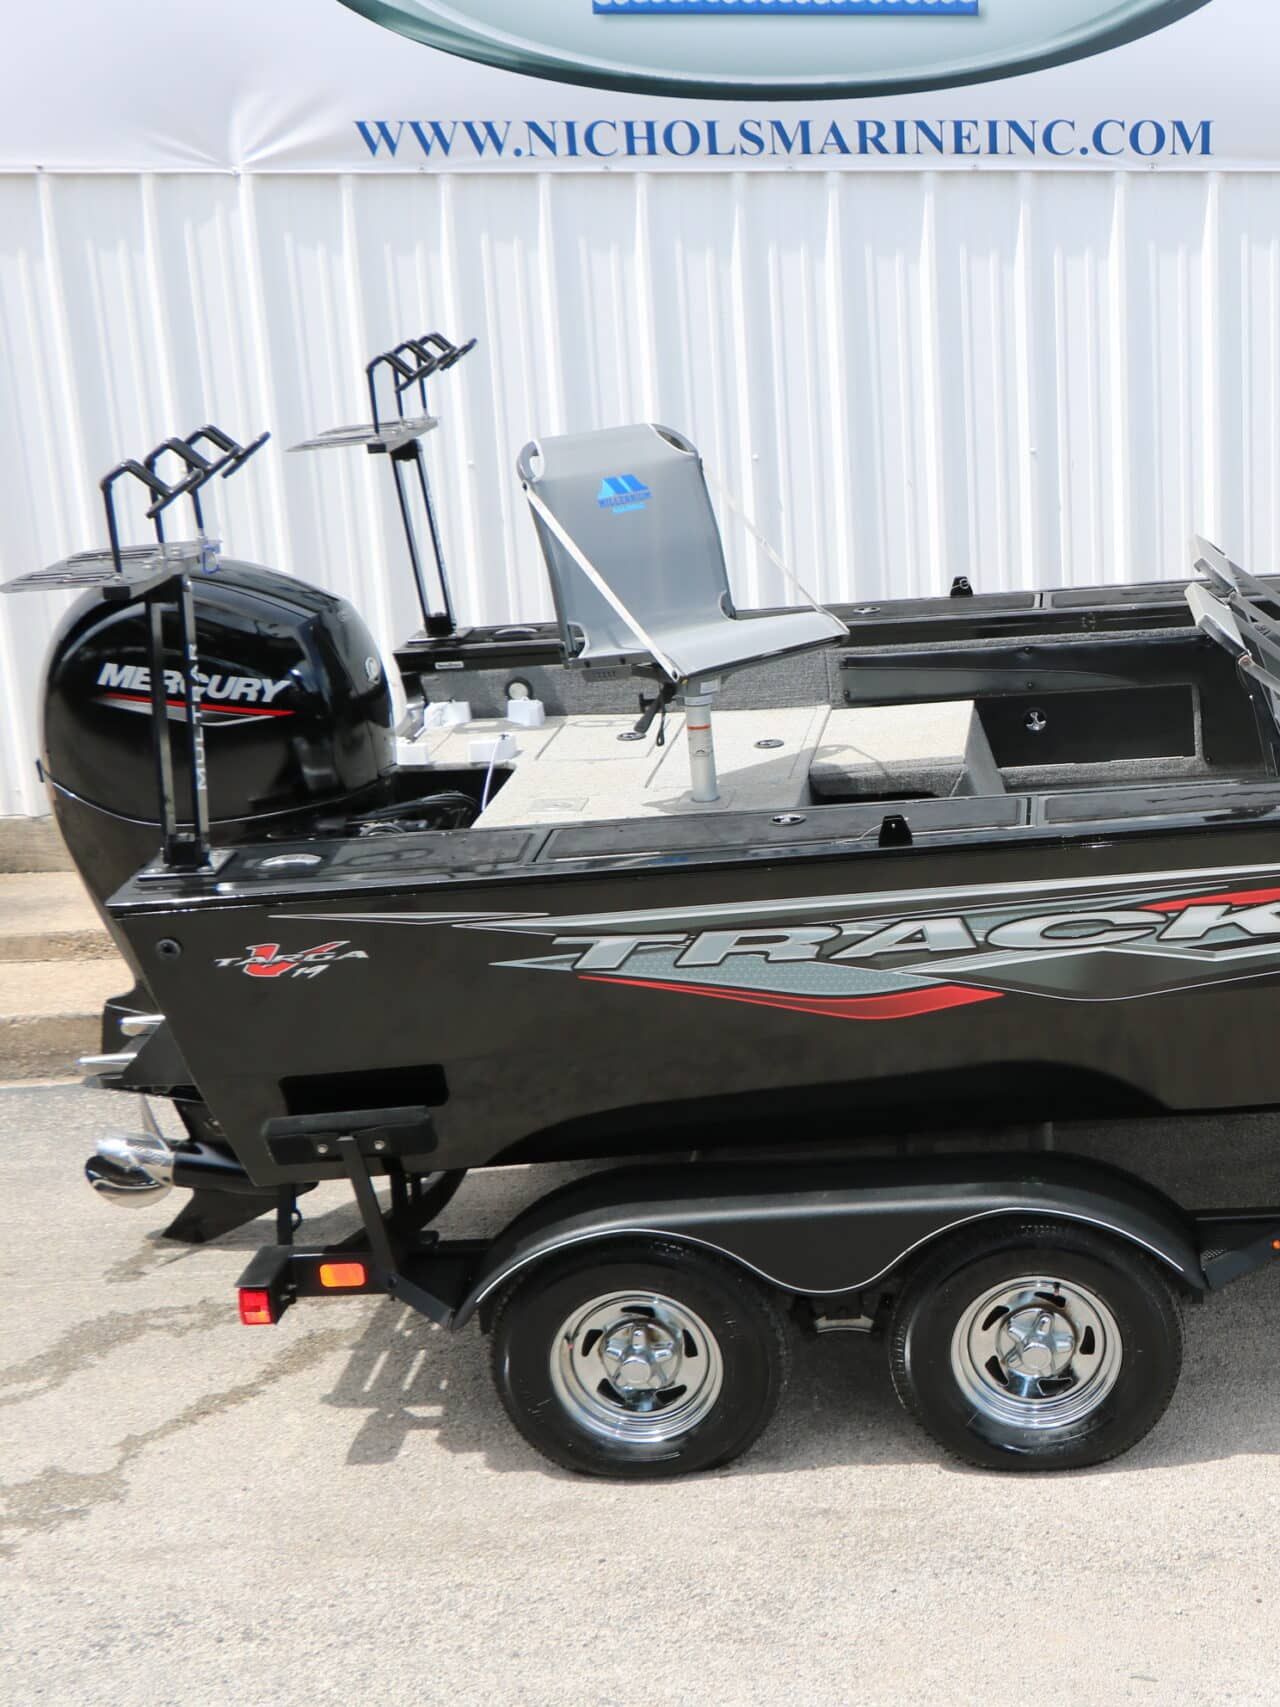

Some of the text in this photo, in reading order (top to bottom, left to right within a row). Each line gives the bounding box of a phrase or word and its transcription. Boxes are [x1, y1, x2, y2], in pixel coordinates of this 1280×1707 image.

[354, 118, 1215, 158] WWW.NICHOLSMARINEINC.COM
[97, 662, 291, 702] MERCURY
[214, 950, 369, 967] TARGA
[291, 964, 330, 979] 19
